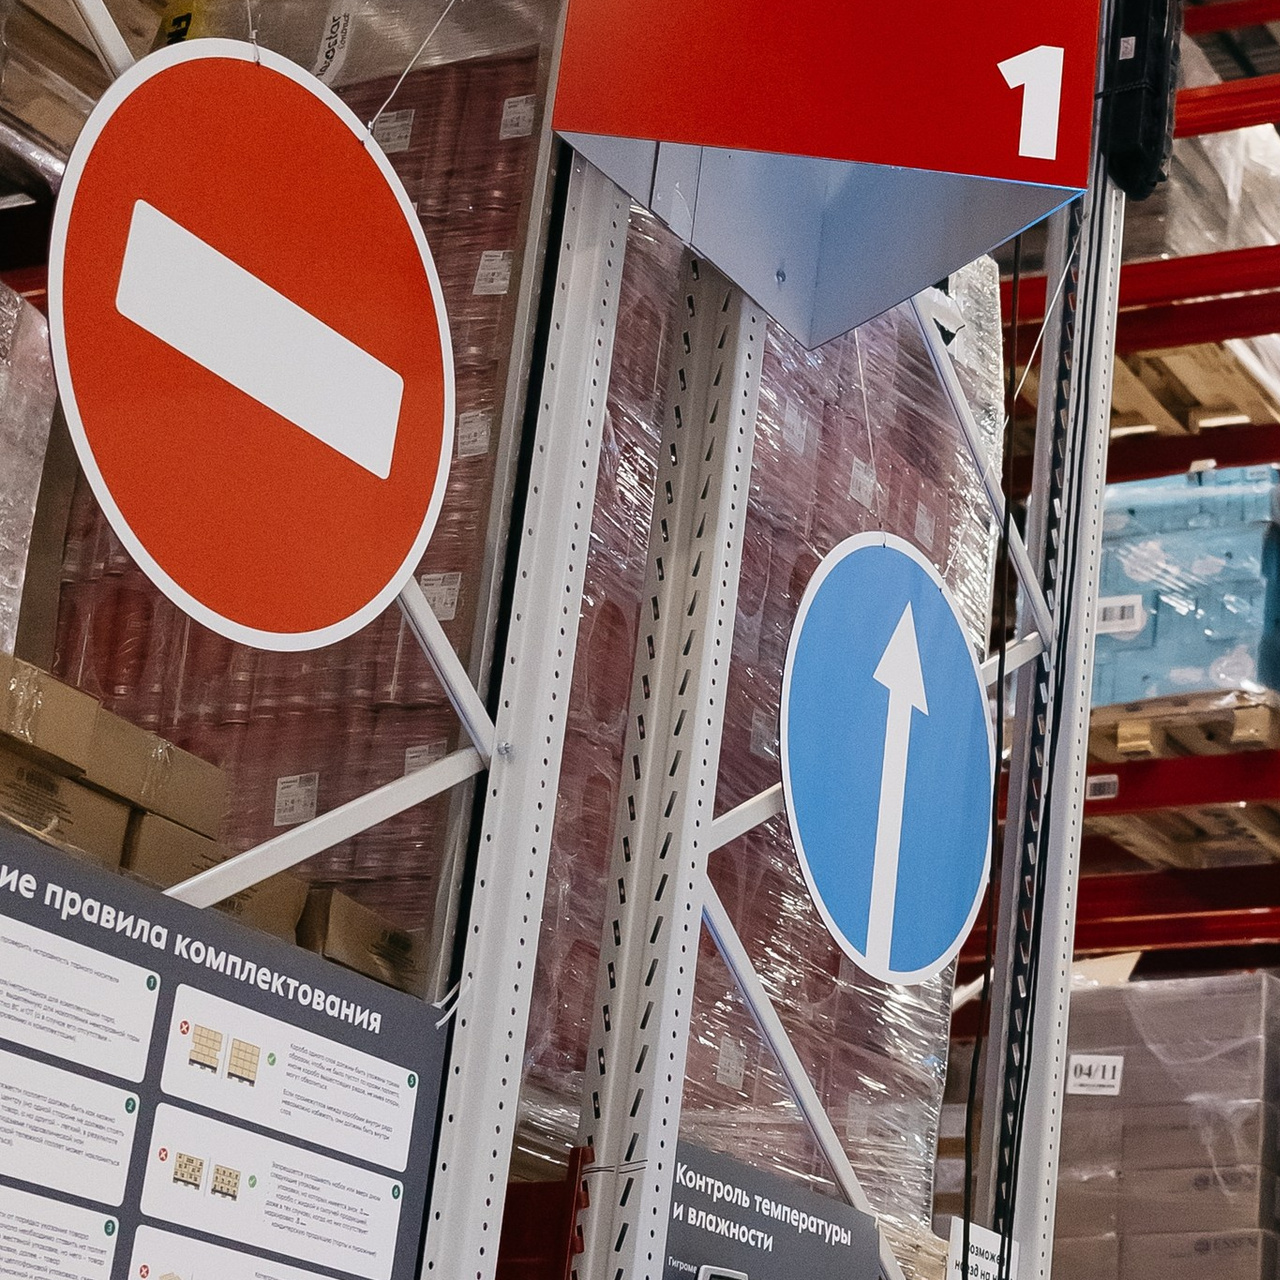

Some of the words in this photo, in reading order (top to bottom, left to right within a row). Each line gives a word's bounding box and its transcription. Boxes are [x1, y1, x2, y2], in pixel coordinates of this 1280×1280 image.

[997, 46, 1064, 160] 1
[44, 883, 168, 949] правила
[175, 936, 382, 1034] комплектования
[1073, 1064, 1118, 1081] 04/11
[673, 1202, 683, 1221] и
[687, 1207, 774, 1252] влажности
[676, 1162, 750, 1209] Контроль
[754, 1194, 852, 1246] температуры
[668, 1256, 698, 1274] Гигроме
[968, 1243, 1004, 1266] озможе
